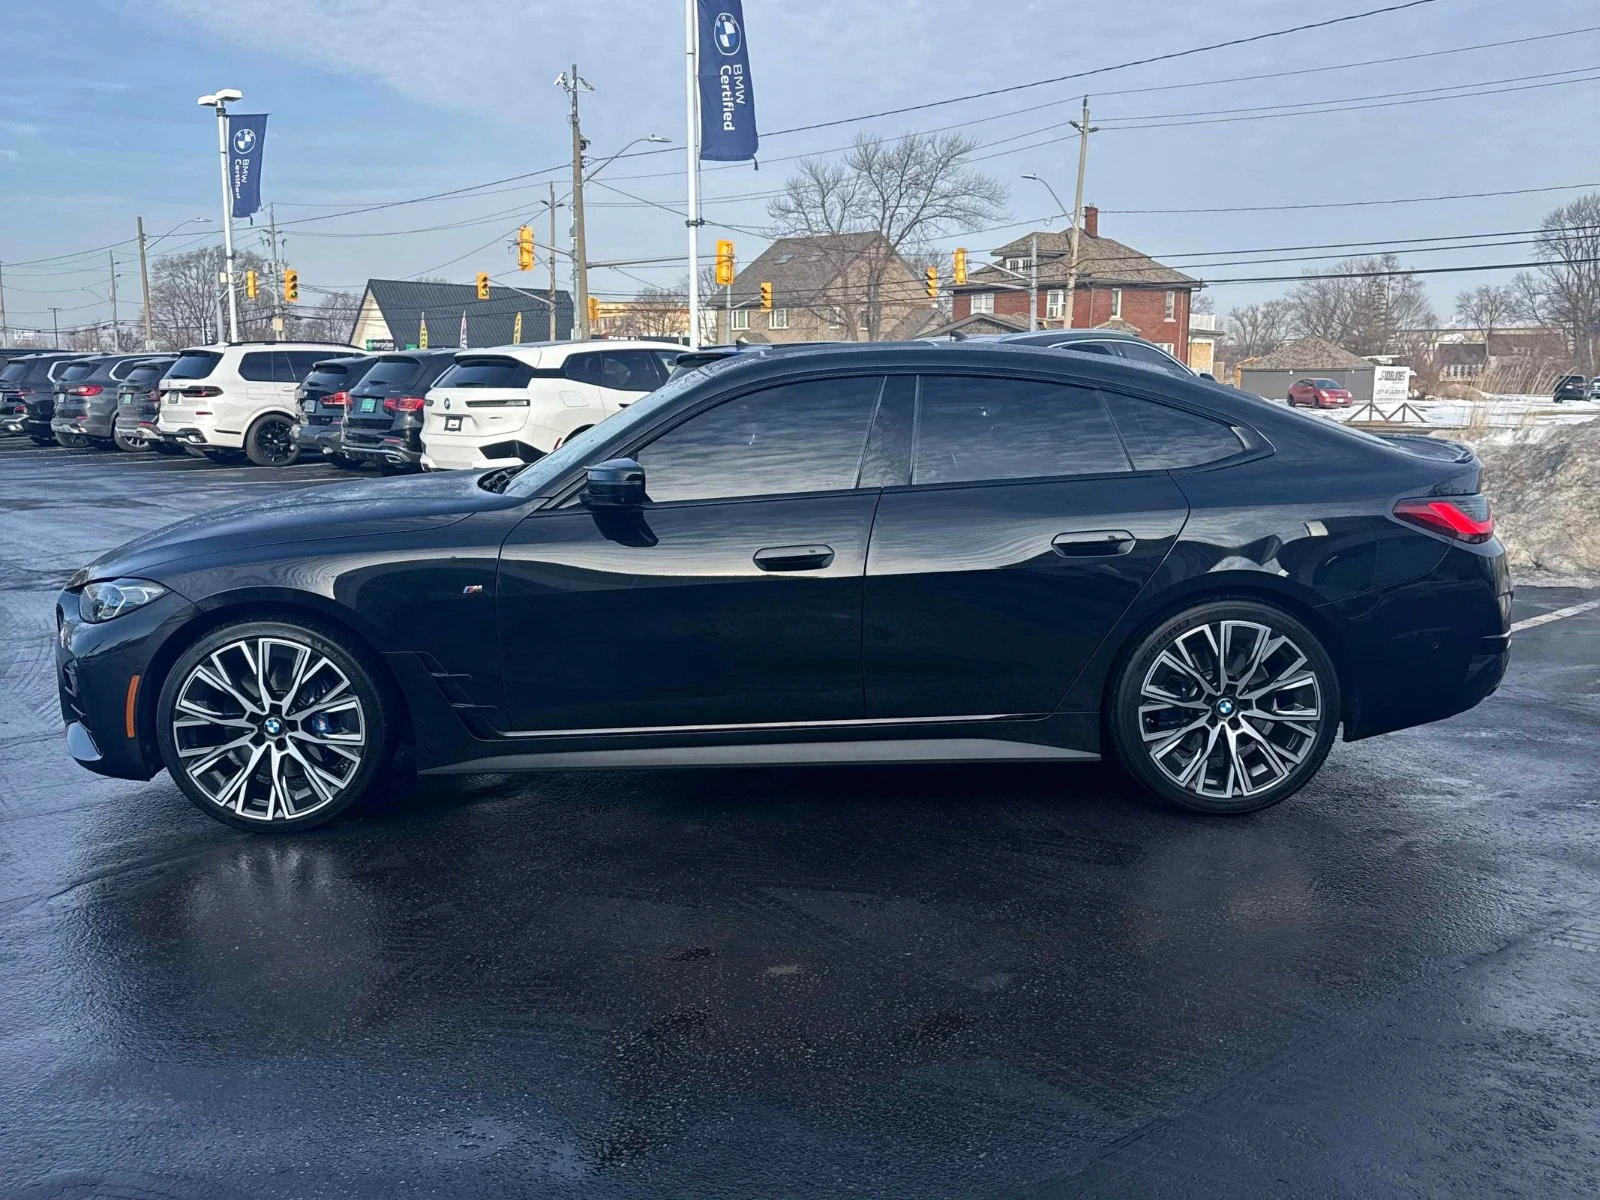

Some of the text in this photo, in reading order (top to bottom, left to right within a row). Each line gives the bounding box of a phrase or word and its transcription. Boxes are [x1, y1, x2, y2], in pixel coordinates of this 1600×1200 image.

[720, 65, 736, 131] Certified
[733, 64, 745, 105] BMW
[241, 159, 250, 183] BMW
[367, 341, 394, 349] enterprise
